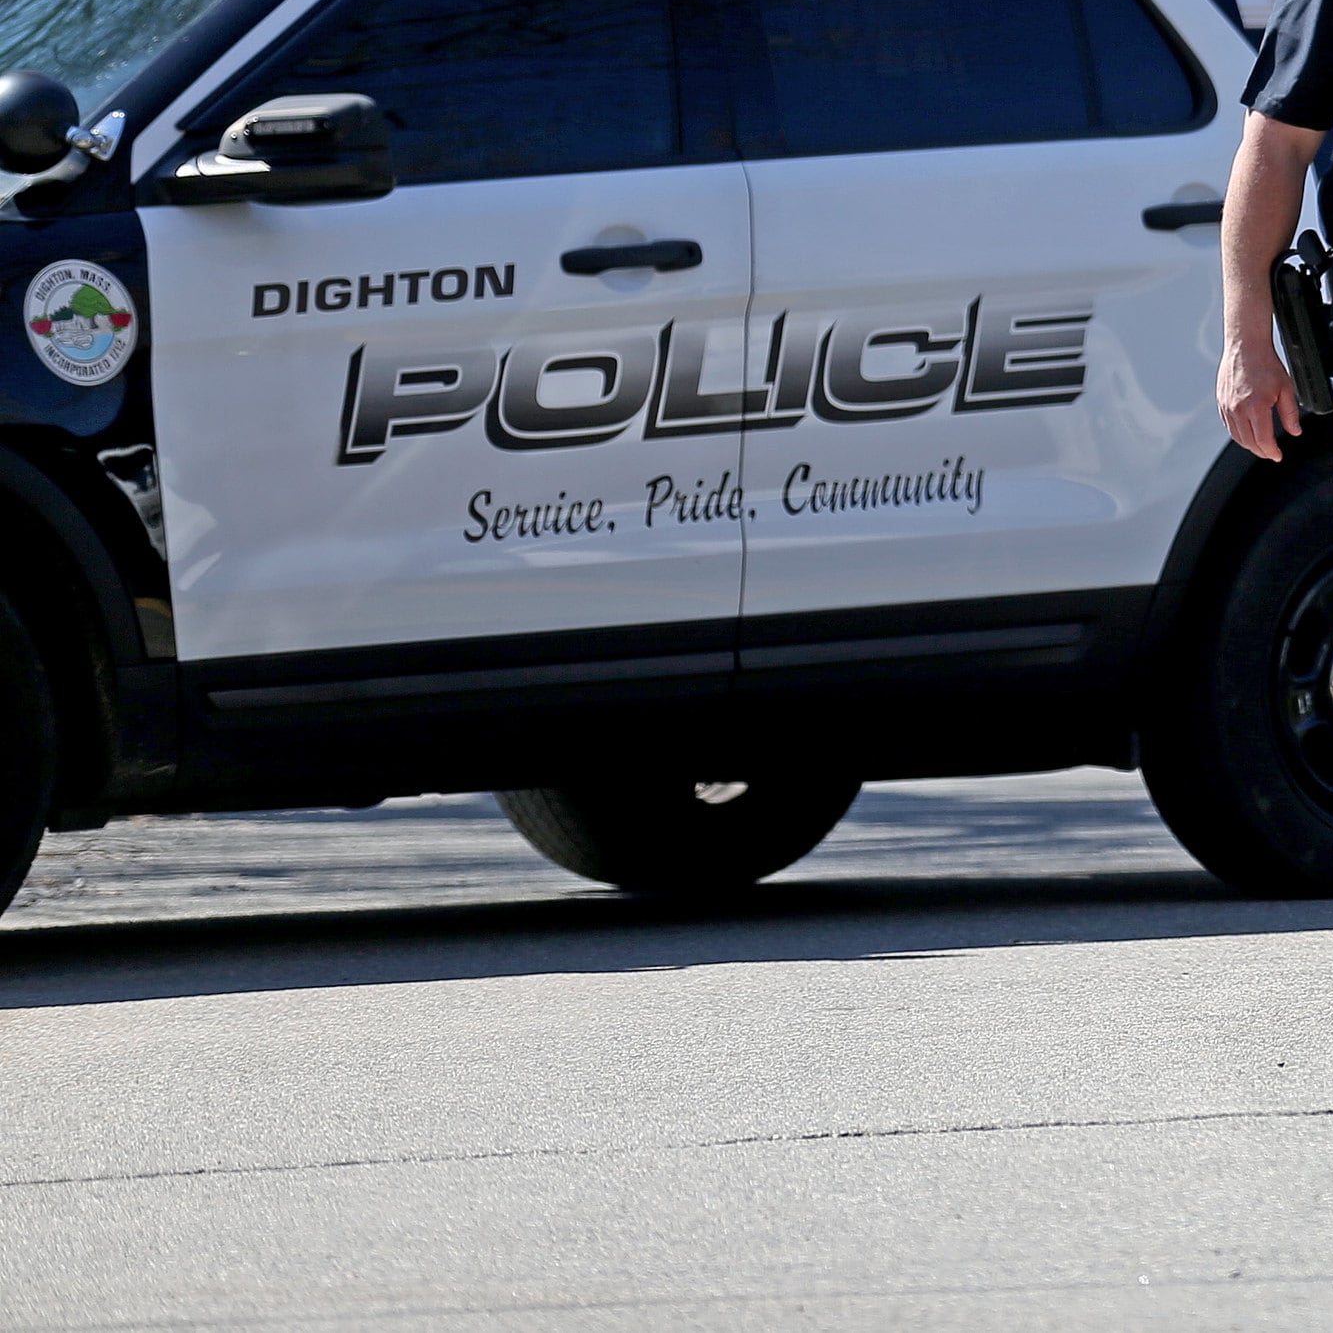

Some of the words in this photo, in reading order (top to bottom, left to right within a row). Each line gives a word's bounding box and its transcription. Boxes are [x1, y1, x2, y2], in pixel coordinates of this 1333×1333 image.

[252, 264, 516, 317] DIGHTON
[44, 344, 111, 377] INCORPORATED
[336, 293, 1093, 465] POLICE
[783, 455, 984, 516] Community
